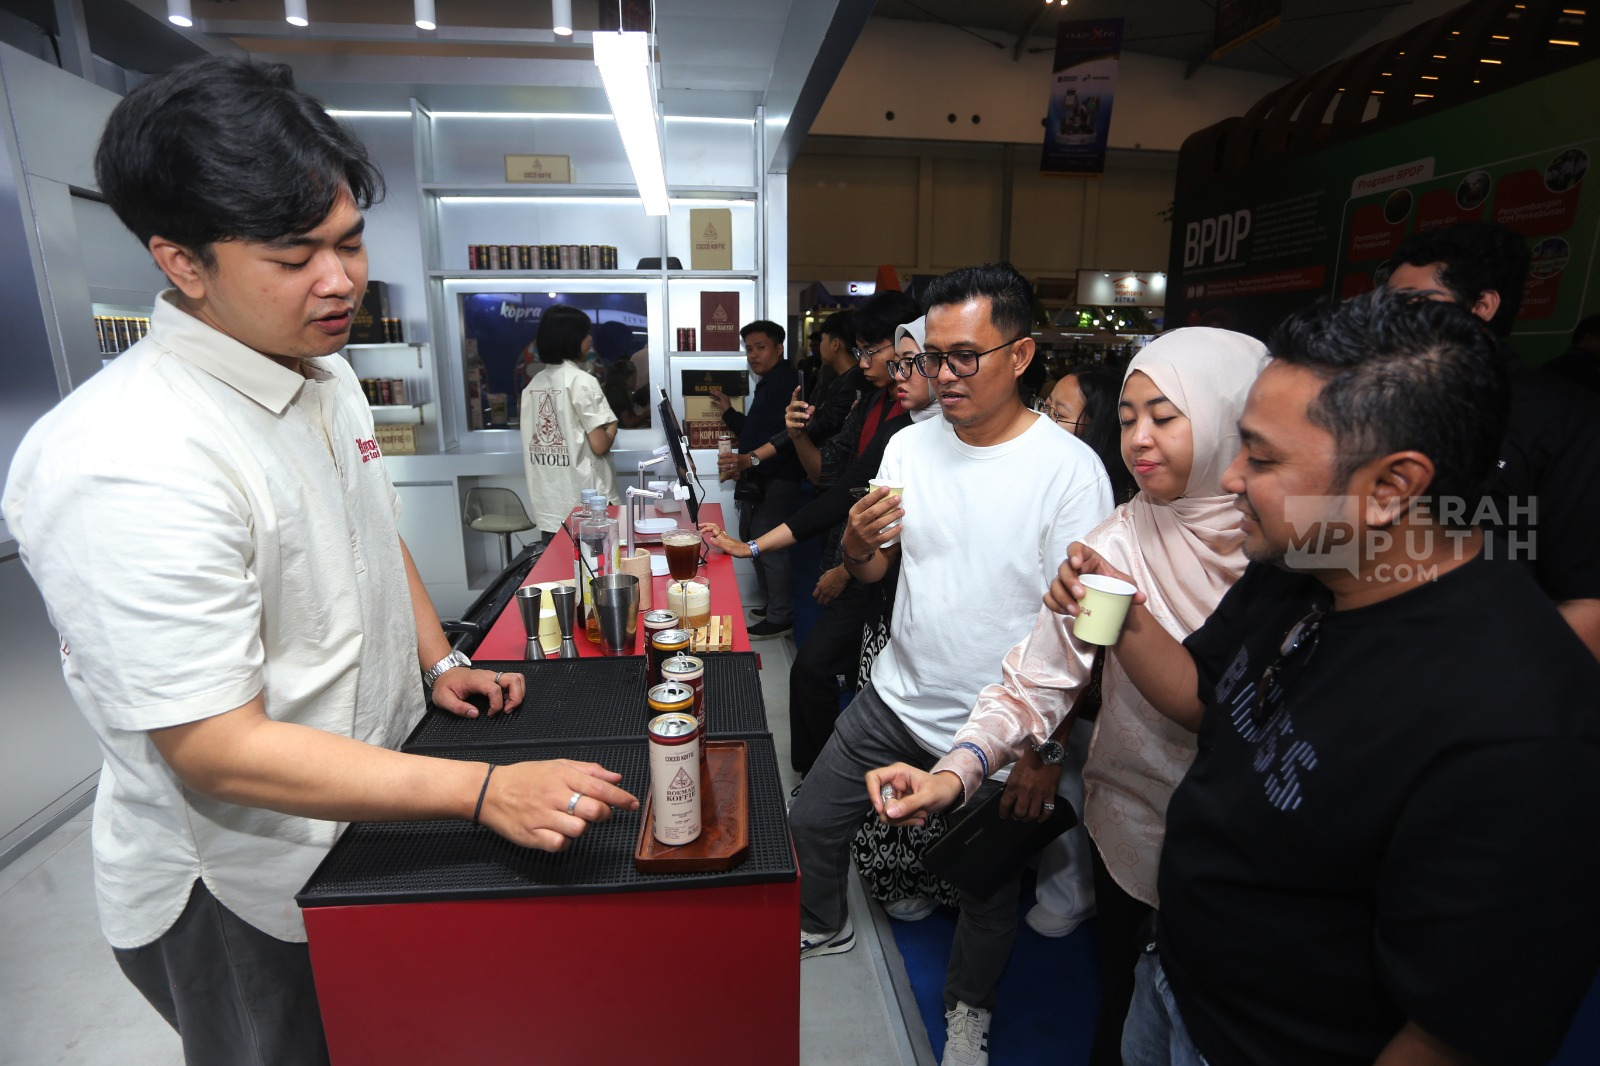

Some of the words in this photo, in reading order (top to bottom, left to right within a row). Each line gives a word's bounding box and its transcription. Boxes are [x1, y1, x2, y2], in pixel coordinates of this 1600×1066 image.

[1358, 175, 1395, 189] Program
[1396, 164, 1424, 180] BPDP
[1183, 209, 1251, 268] BPDP
[500, 301, 542, 322] kopra
[700, 430, 714, 440] KOPI
[530, 452, 570, 467] UNTOLD
[680, 751, 695, 761] KOFFIE
[666, 785, 696, 796] ROEMAH
[666, 790, 696, 802] KOFFIE
